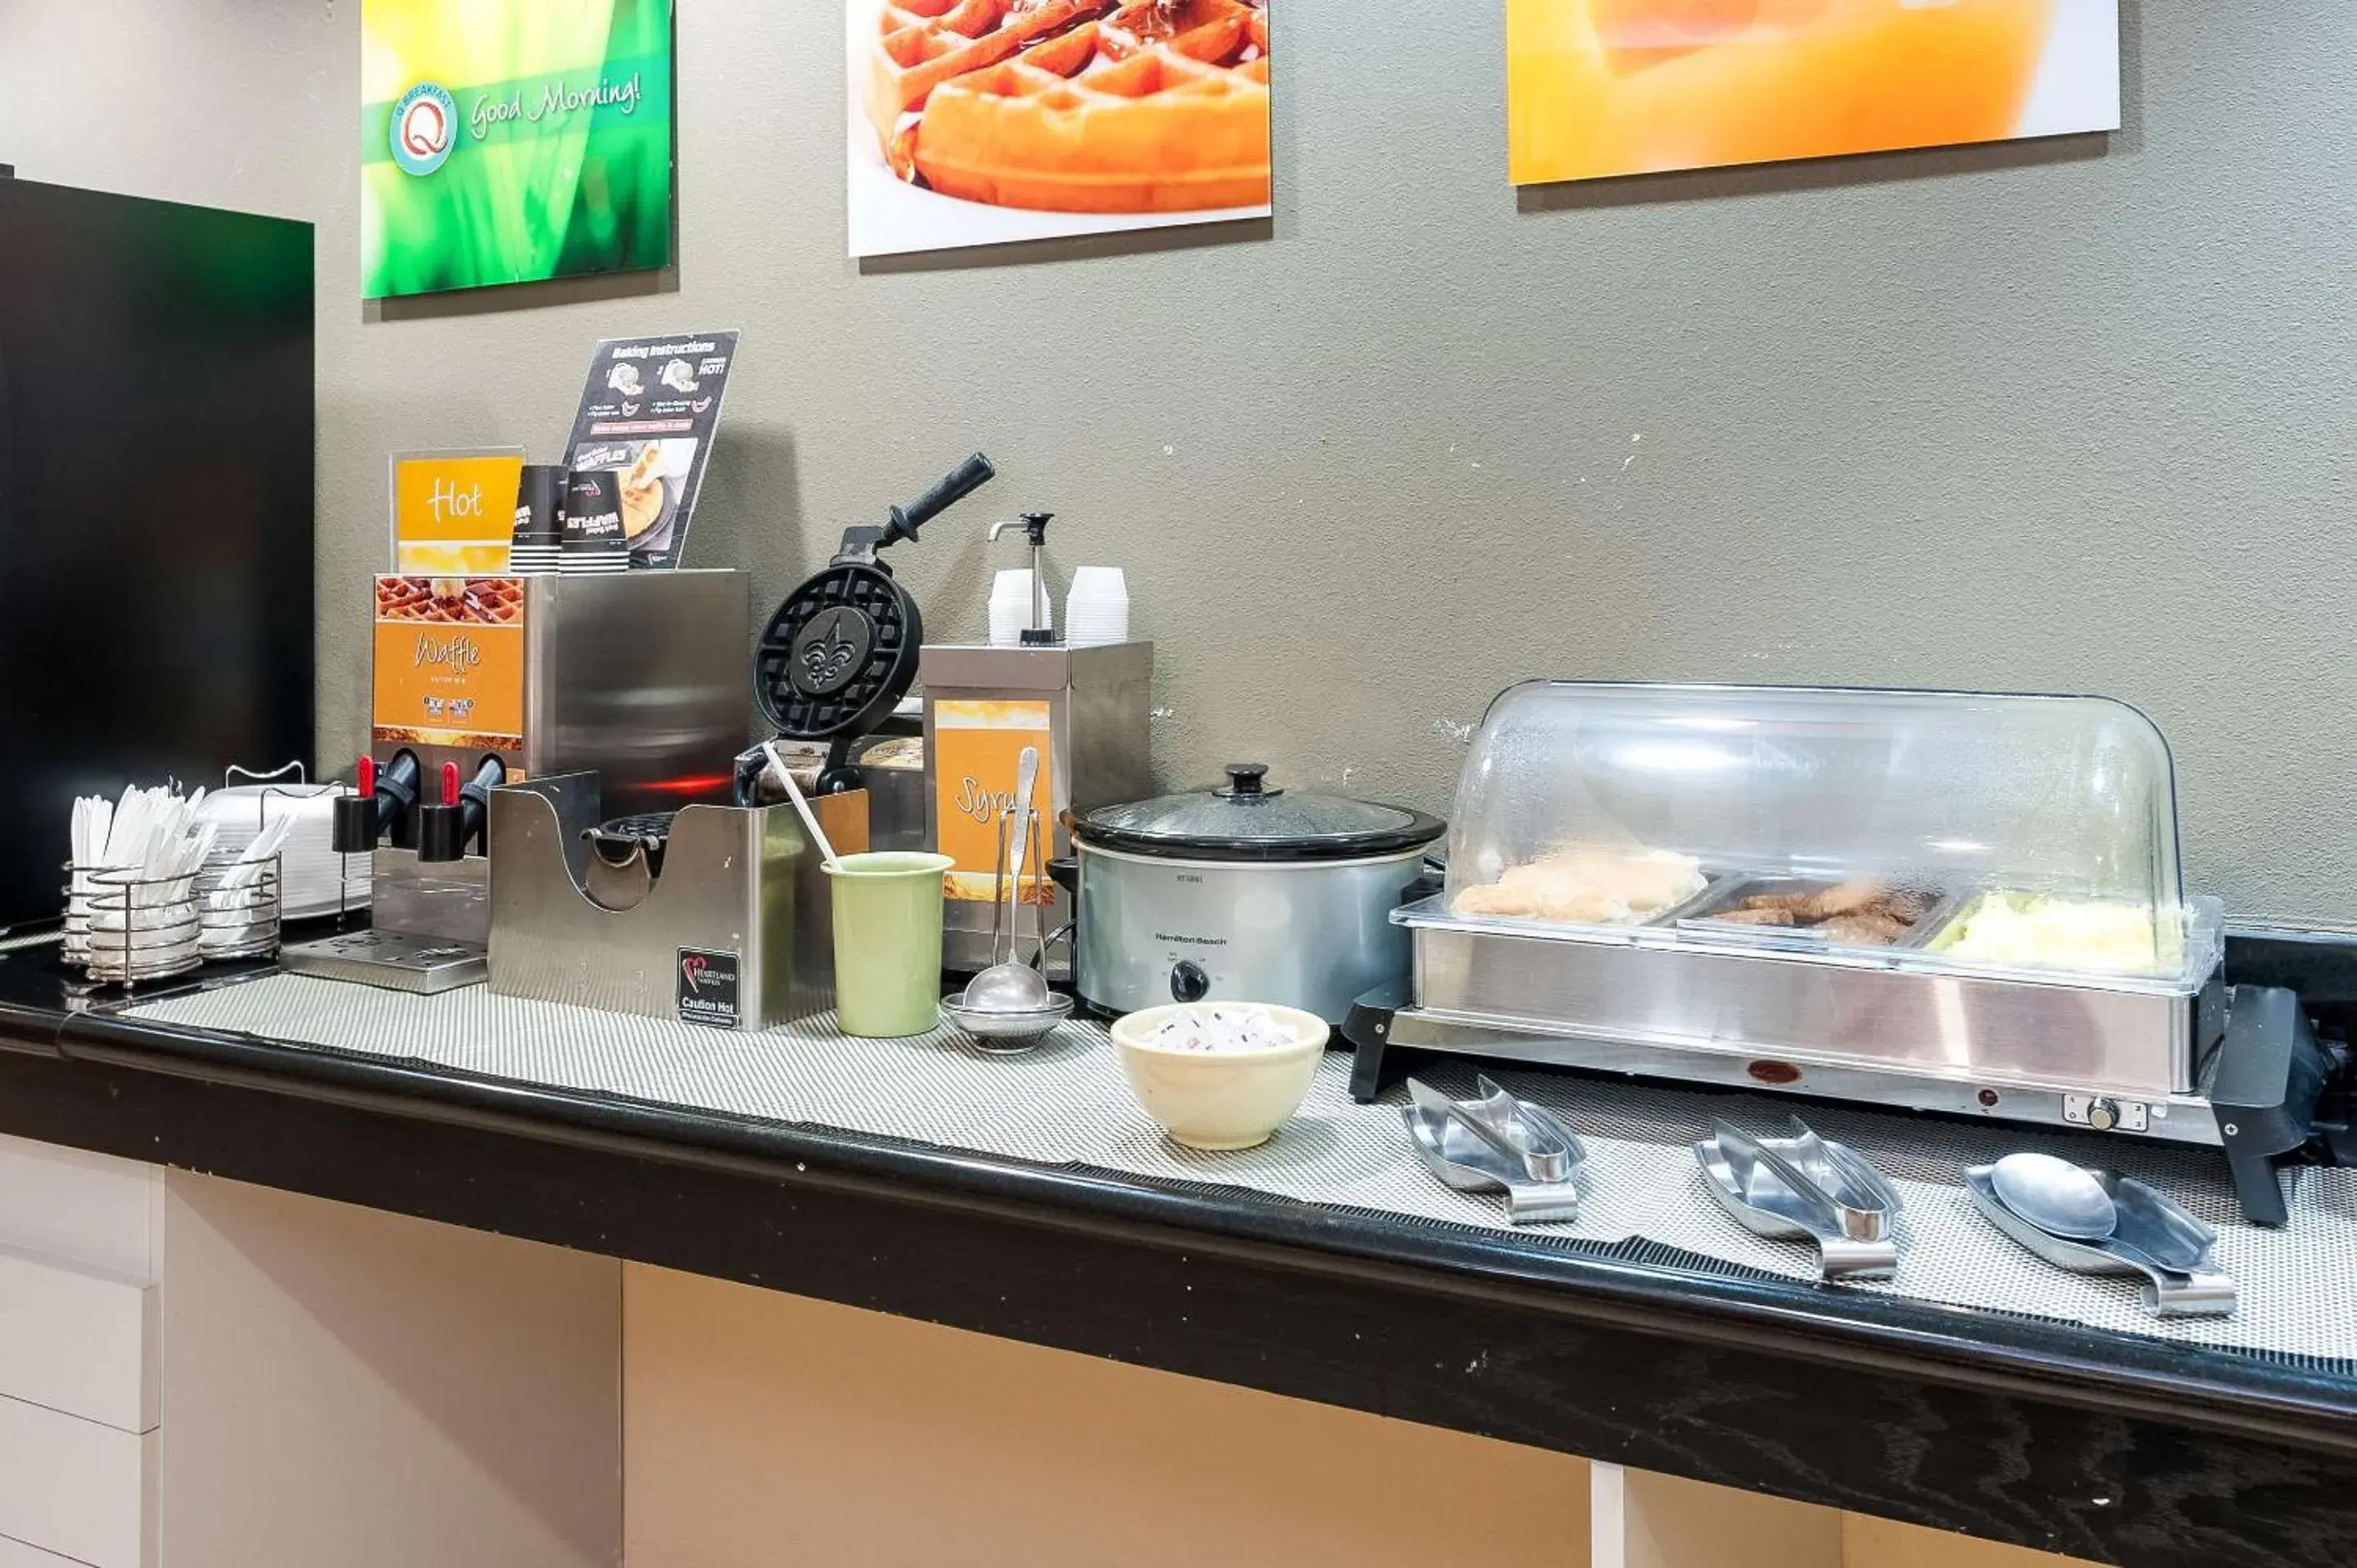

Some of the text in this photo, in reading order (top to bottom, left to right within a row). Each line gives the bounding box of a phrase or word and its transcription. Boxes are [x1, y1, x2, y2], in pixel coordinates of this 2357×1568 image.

[471, 71, 642, 140] Good Morning!
[404, 101, 448, 155] Q
[612, 341, 716, 358] Baking Instructions
[426, 477, 483, 524] Hot
[567, 511, 620, 529] WAFFLES
[415, 631, 480, 674] Waffle
[954, 777, 1017, 823] Syru
[1156, 933, 1226, 945] Hamilton Beach
[694, 967, 735, 981] HEARTLAND
[682, 997, 734, 1014] Caution Hot
